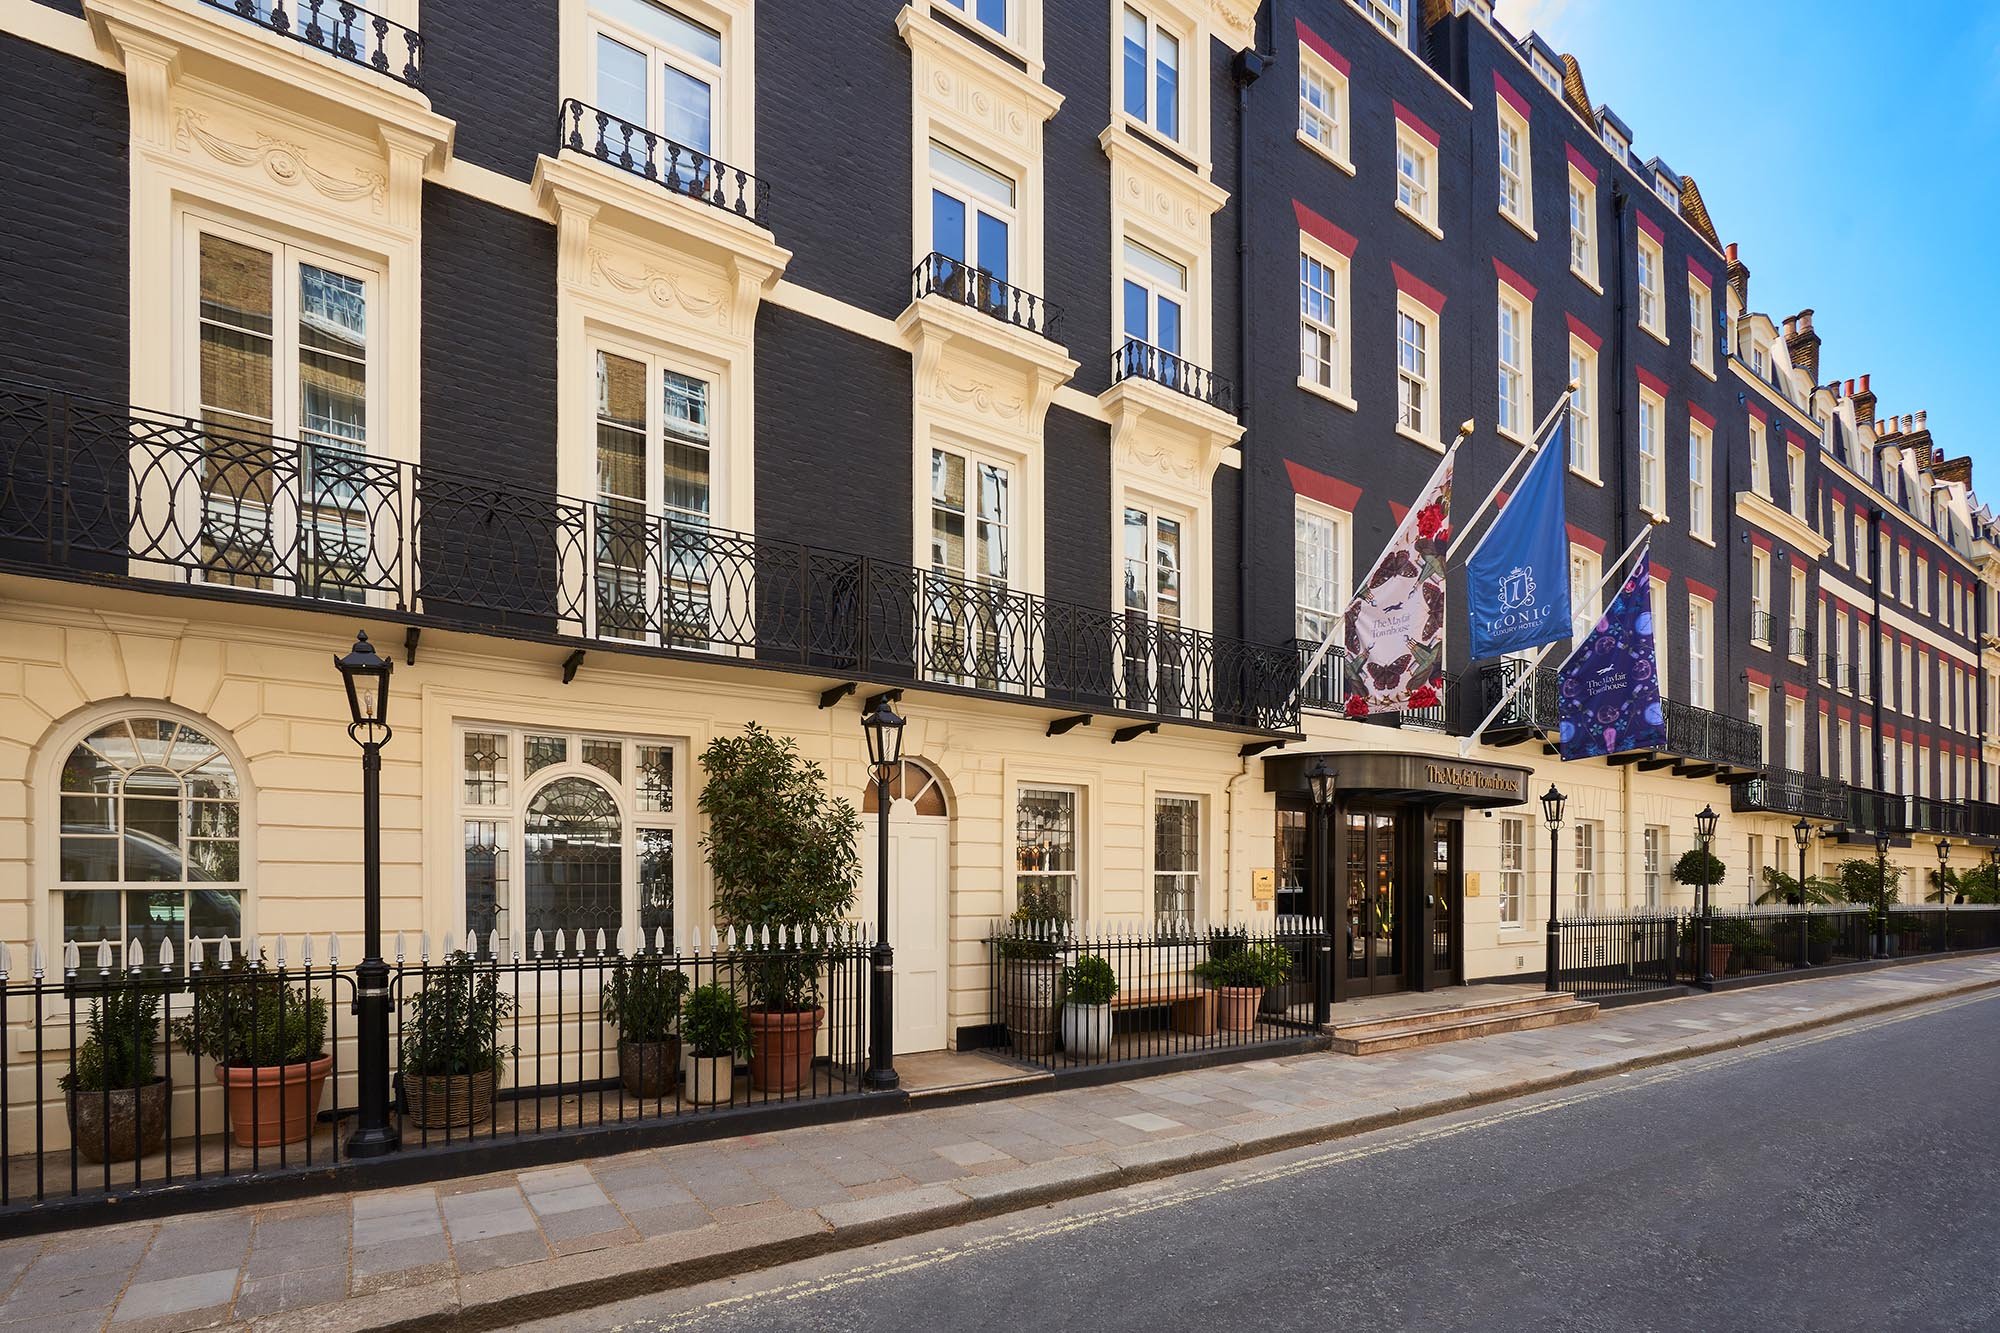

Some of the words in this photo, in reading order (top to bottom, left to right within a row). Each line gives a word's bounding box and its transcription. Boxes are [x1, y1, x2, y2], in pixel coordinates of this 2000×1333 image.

[1372, 619, 1386, 628] The
[1487, 604, 1551, 632] ICONIC
[1492, 626, 1517, 636] LUXURY
[1518, 619, 1543, 630] HOTELS
[1586, 680, 1603, 688] The
[1602, 672, 1626, 684] Mayfair
[1586, 681, 1627, 696] Townhouse
[1425, 764, 1446, 783] The
[1444, 767, 1477, 790] Mayfair
[1474, 771, 1519, 792] Townhouse
